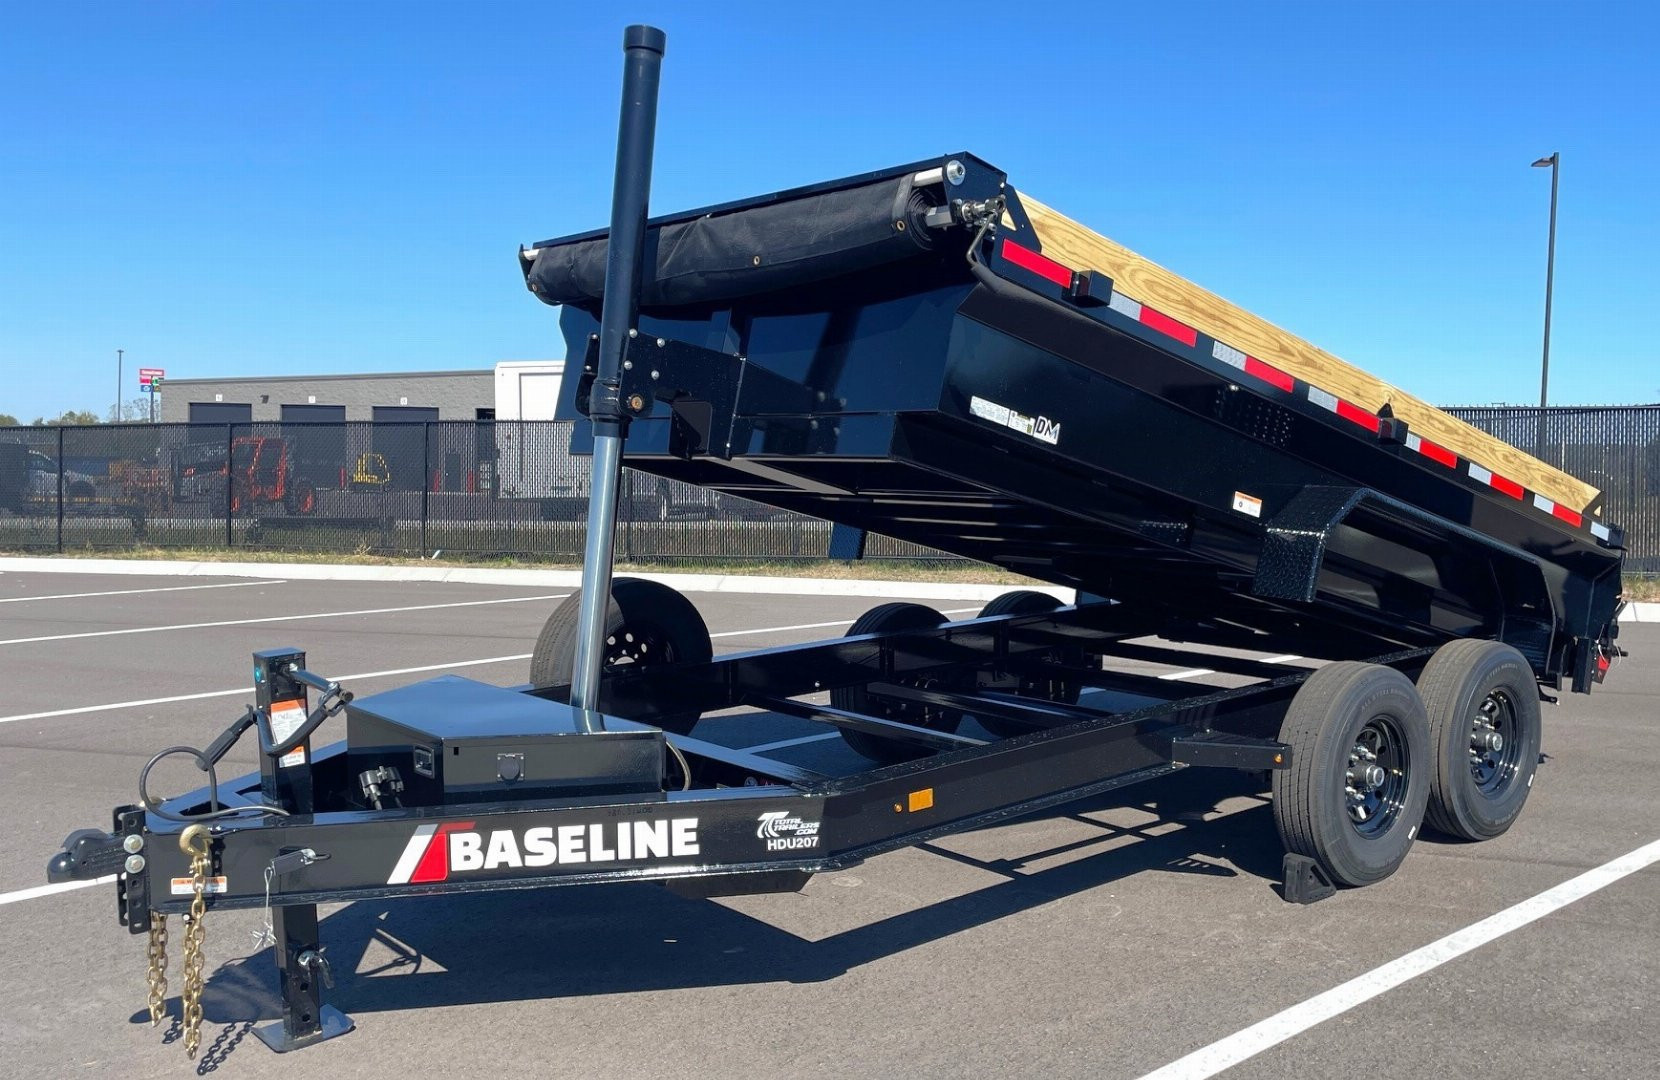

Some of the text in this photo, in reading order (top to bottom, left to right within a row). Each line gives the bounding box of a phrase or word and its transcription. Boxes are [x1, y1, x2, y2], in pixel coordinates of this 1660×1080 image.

[773, 821, 820, 831] TRAILERS
[449, 817, 700, 872] BASELINE
[767, 836, 819, 851] HDU207
